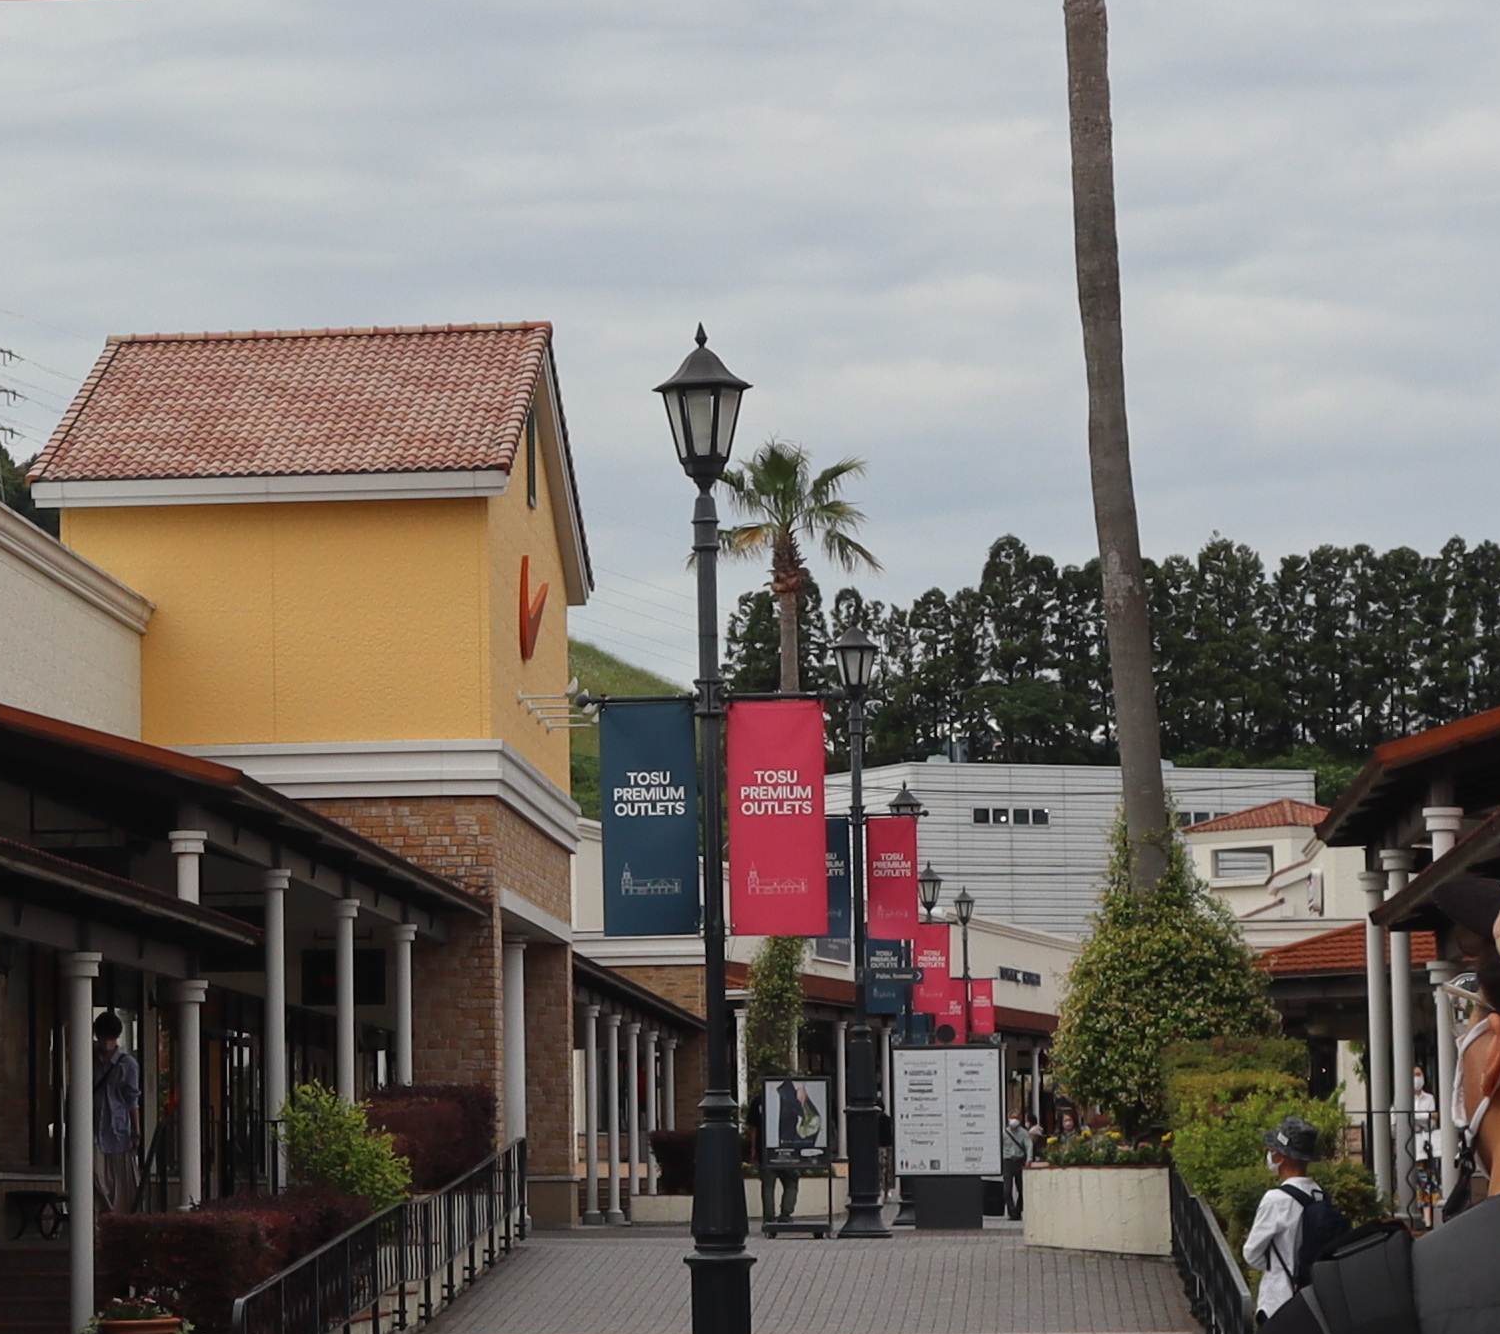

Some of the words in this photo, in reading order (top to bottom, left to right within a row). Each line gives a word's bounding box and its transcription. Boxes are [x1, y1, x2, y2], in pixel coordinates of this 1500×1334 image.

[627, 771, 670, 786] TOSU
[754, 770, 798, 784] TOSU
[613, 786, 685, 802] PREMIUM
[740, 785, 812, 800] PREMIUM
[880, 852, 905, 861] TOSU
[873, 860, 911, 869] PREMIUM
